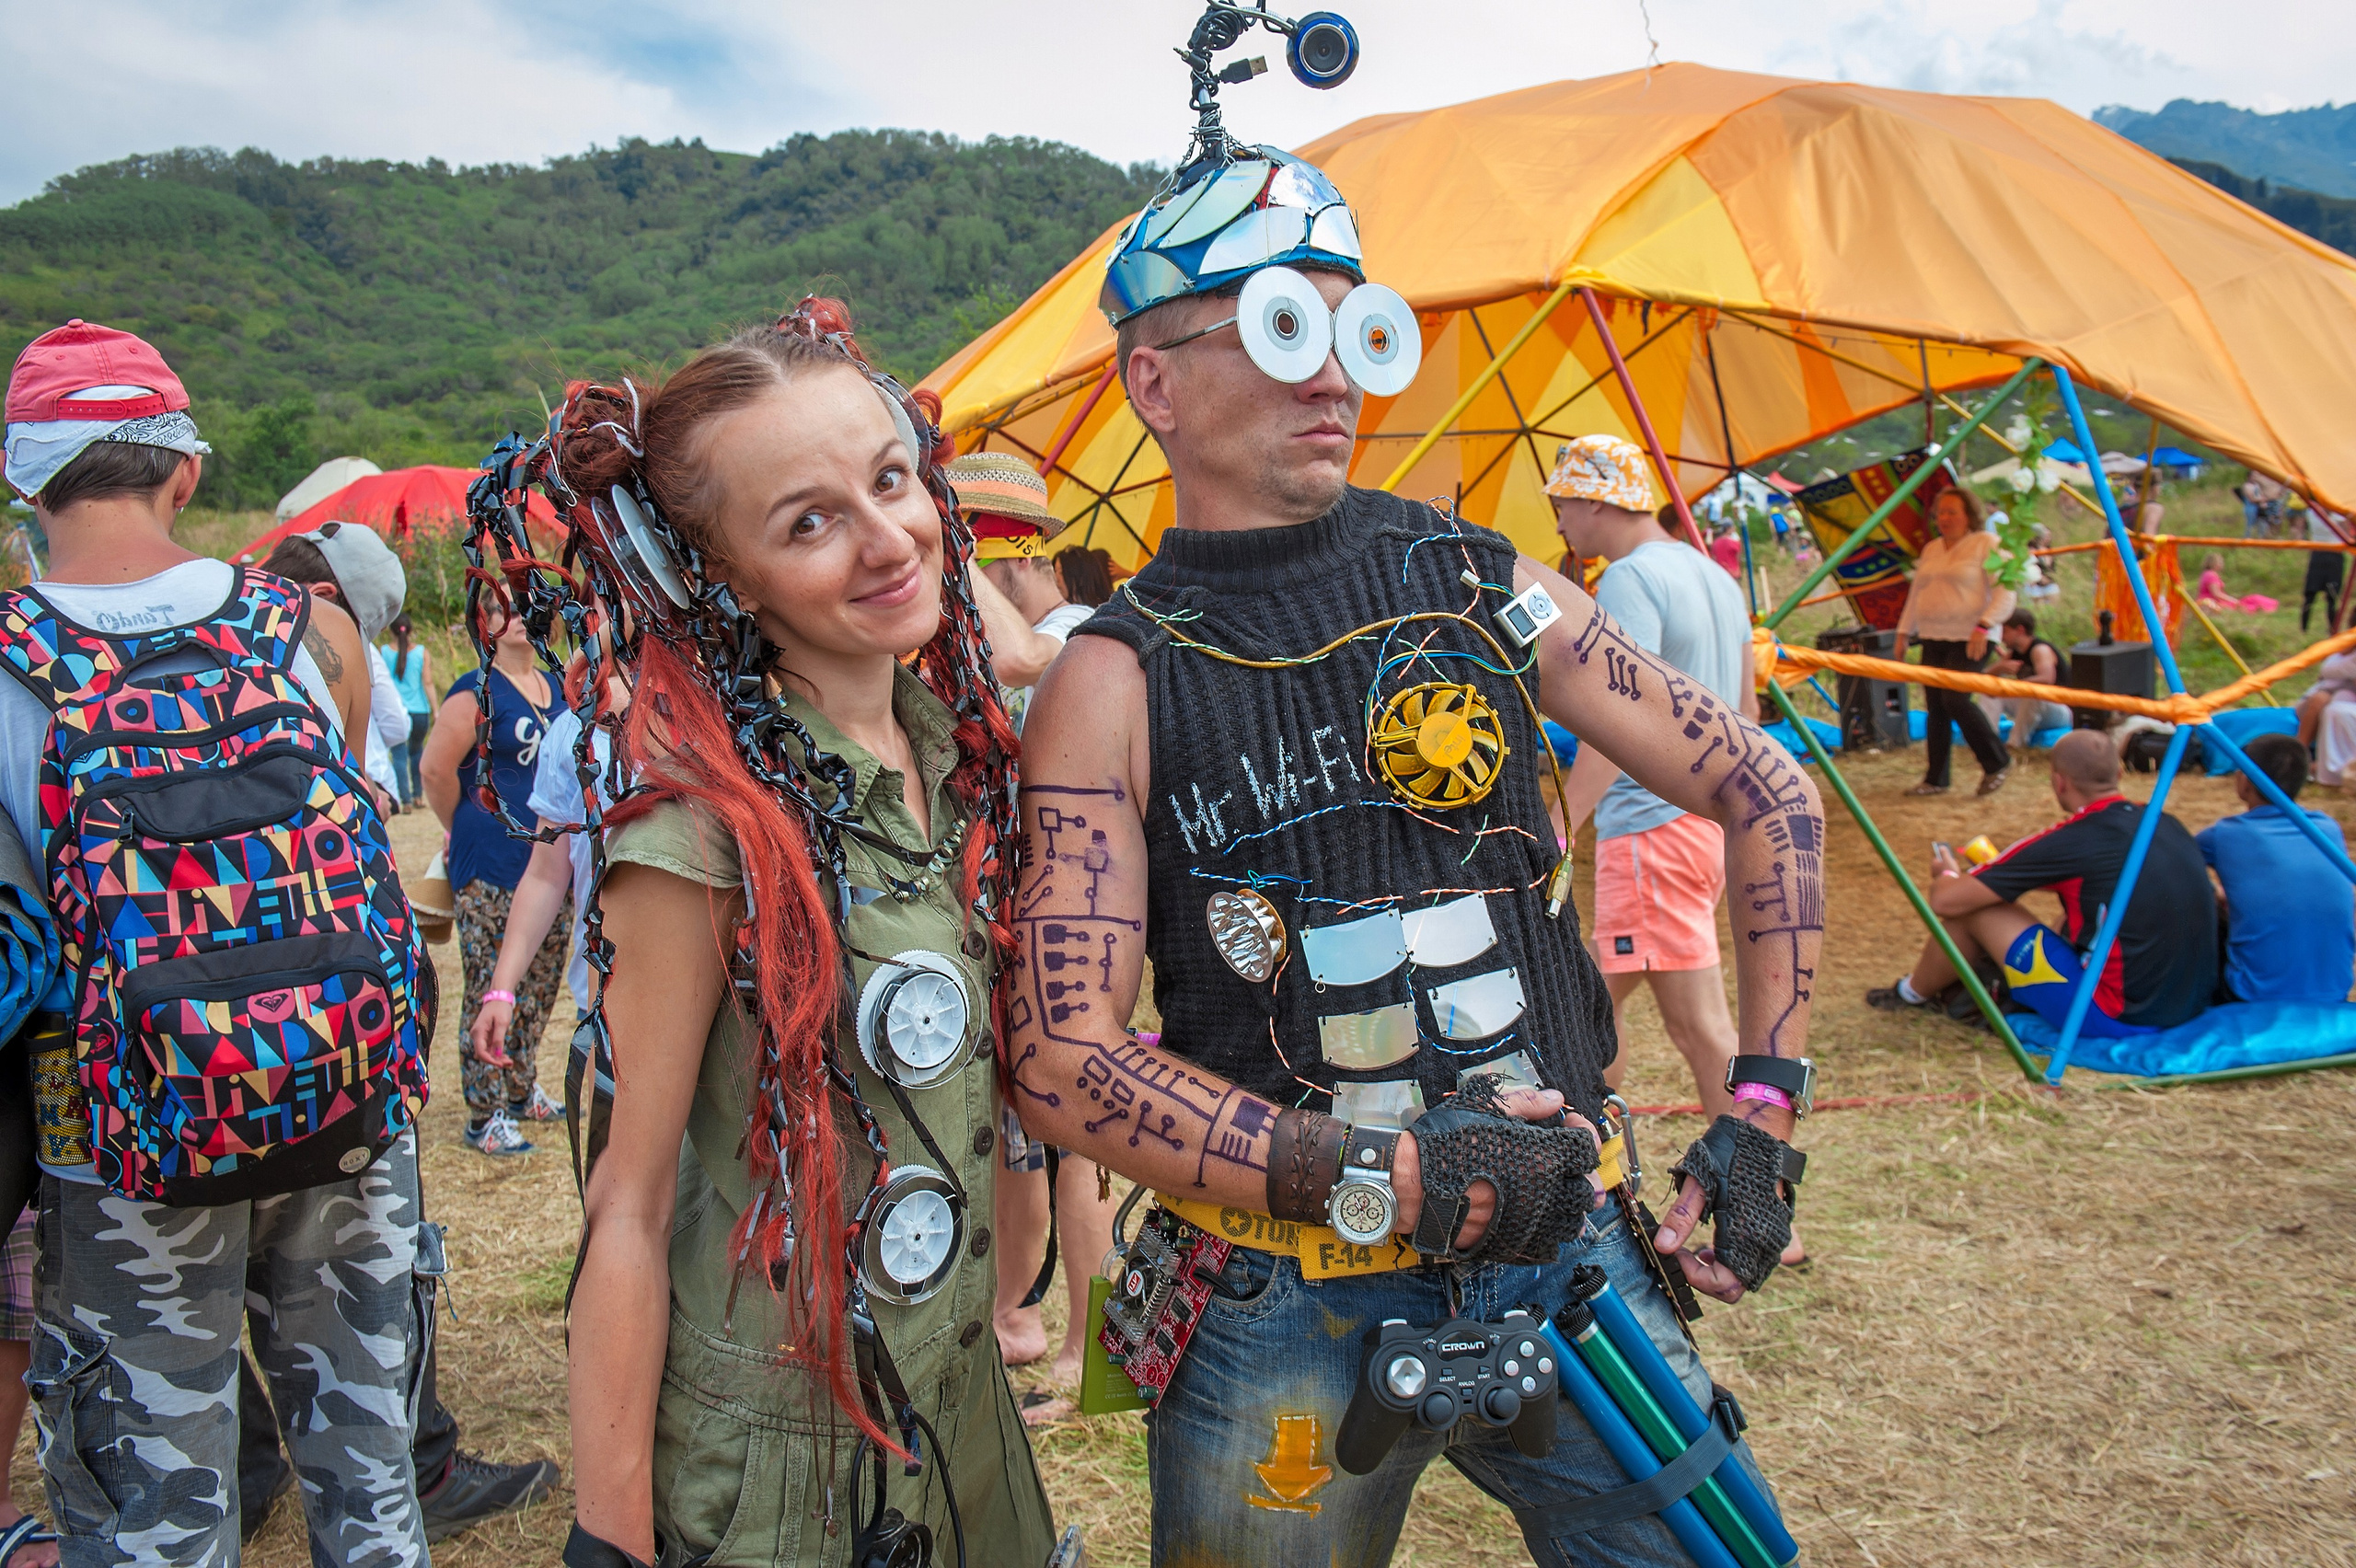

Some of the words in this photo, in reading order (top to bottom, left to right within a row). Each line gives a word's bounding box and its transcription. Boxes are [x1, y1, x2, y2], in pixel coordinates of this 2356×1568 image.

[1240, 725, 1361, 819] Wi-Fi
[343, 1153, 366, 1167] ROXY
[1319, 1242, 1372, 1270] F-14
[1441, 1341, 1484, 1352] CROWN
